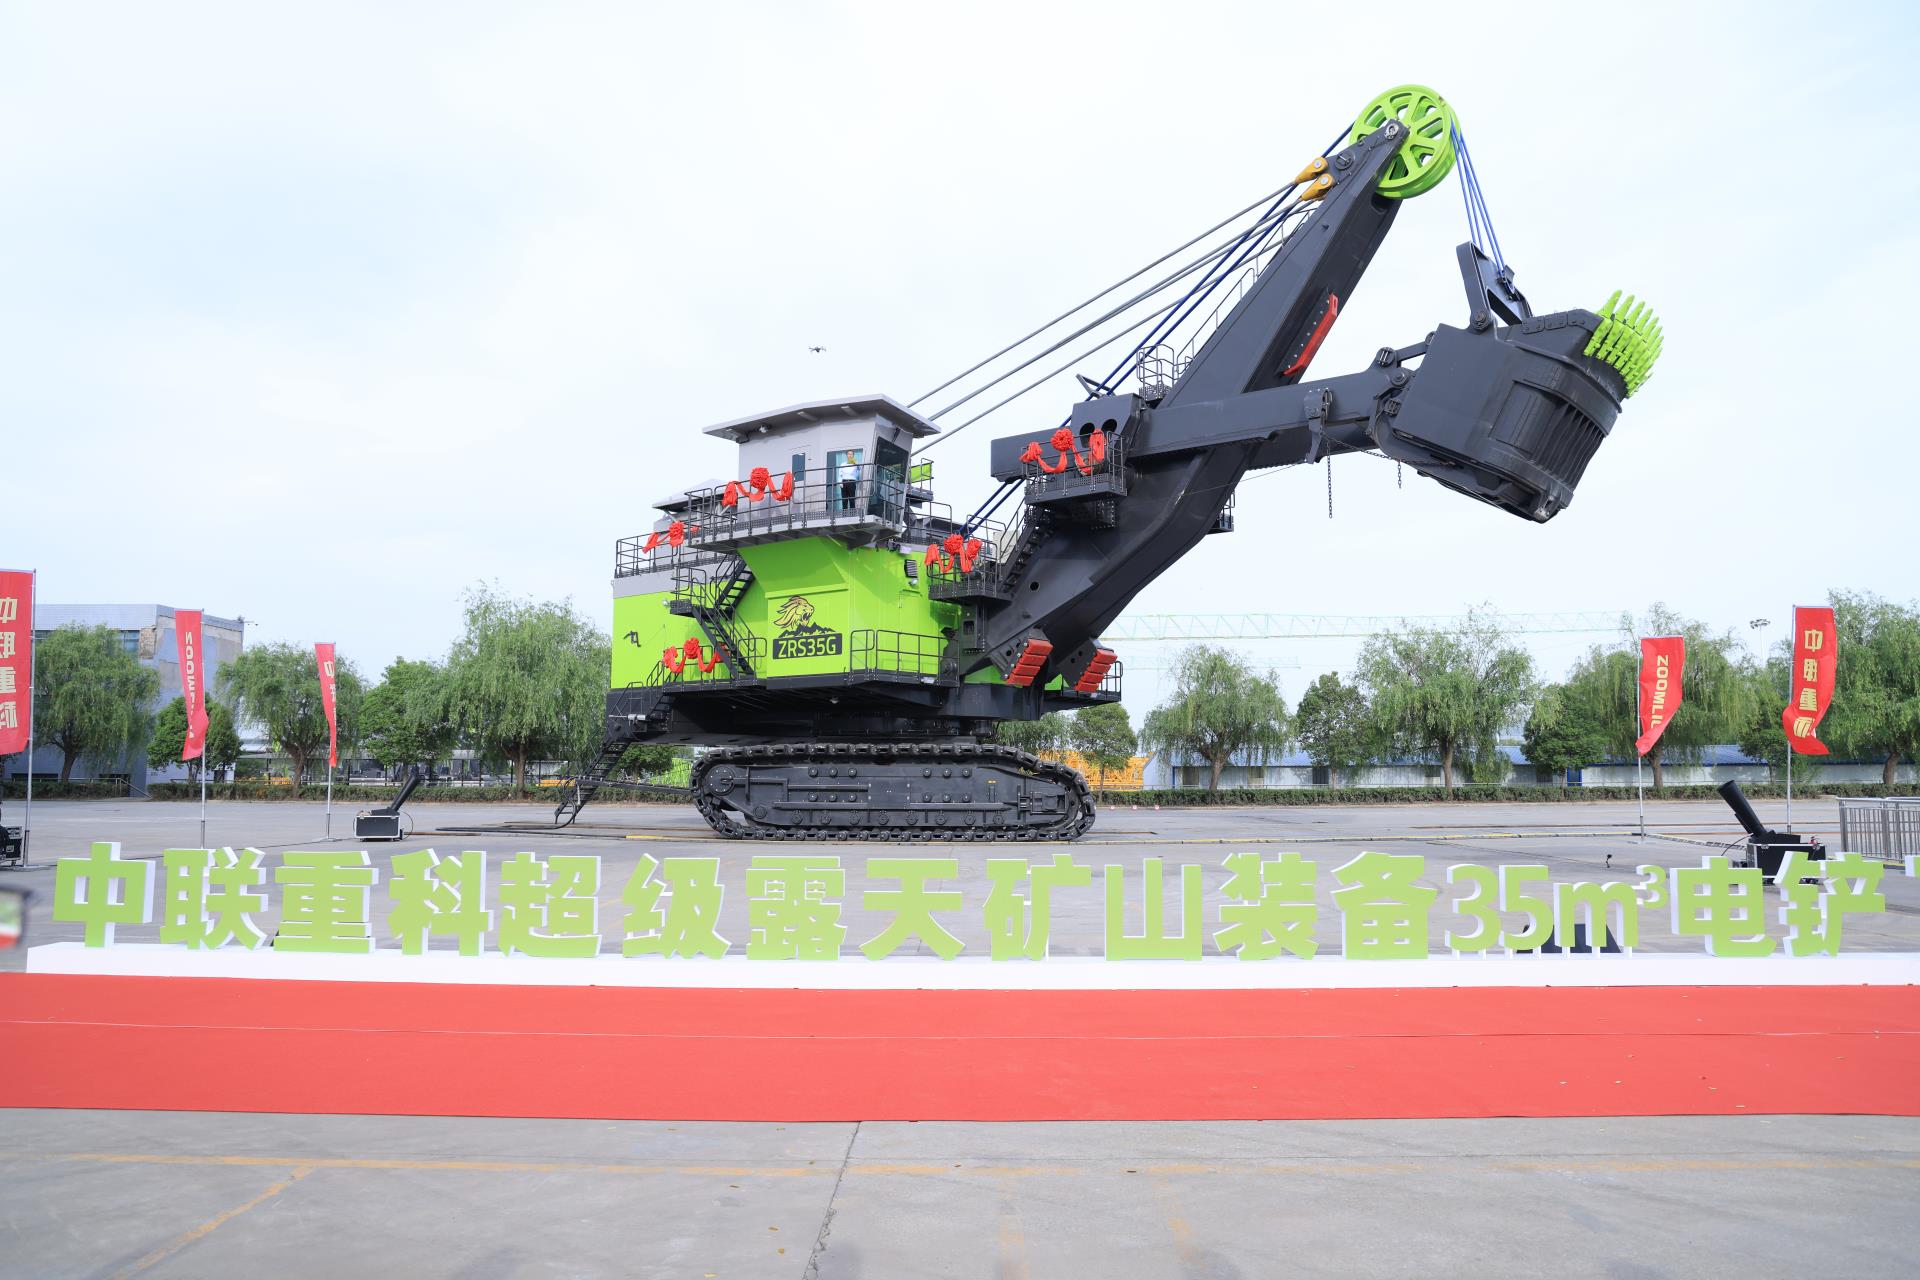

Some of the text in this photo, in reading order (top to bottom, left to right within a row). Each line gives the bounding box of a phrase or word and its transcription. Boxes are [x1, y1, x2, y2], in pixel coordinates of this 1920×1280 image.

[778, 637, 837, 658] ZRS35G
[54, 843, 1920, 960] 中联重科超级露天矿山装备35m³电铲
